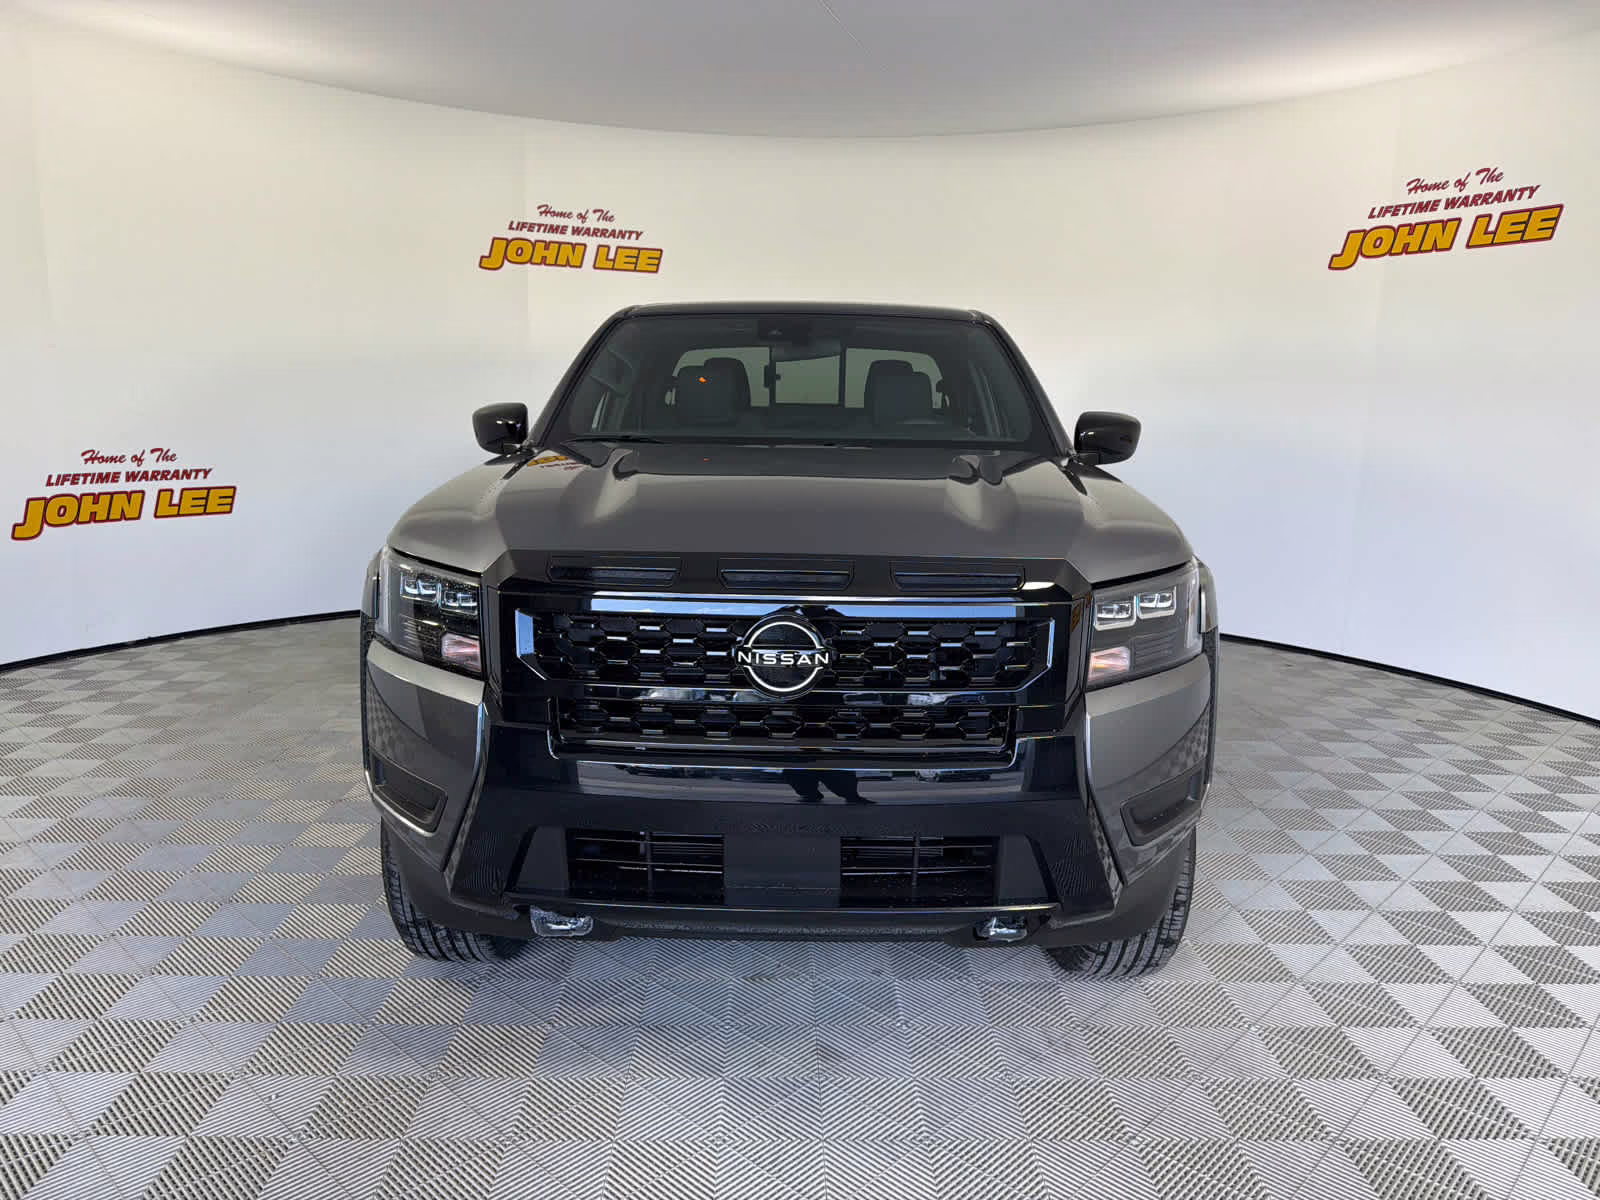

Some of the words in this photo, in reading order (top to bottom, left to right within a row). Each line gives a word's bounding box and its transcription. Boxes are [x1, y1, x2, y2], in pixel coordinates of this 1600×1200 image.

[1406, 178, 1450, 195] Home
[1454, 172, 1471, 192] of
[1475, 167, 1504, 185] The
[1368, 199, 1442, 219] LIFETIME
[1444, 184, 1541, 210] WARRANTY
[537, 204, 573, 219] Home
[577, 209, 590, 224] of
[592, 209, 615, 223] The
[508, 221, 569, 235] LIFETIME
[571, 225, 643, 241] WARRANTY
[1328, 217, 1462, 270] JOHN
[1466, 203, 1564, 249] LEE
[479, 237, 587, 270] JOHN
[593, 244, 663, 274] LEE
[80, 449, 127, 464] Home
[130, 449, 146, 467] of
[150, 448, 178, 463] The
[45, 471, 122, 487] LIFETIME
[124, 468, 213, 483] WARRANTY
[11, 490, 146, 541] JOHN
[153, 486, 237, 519] LEE
[737, 651, 829, 665] NISSAN
